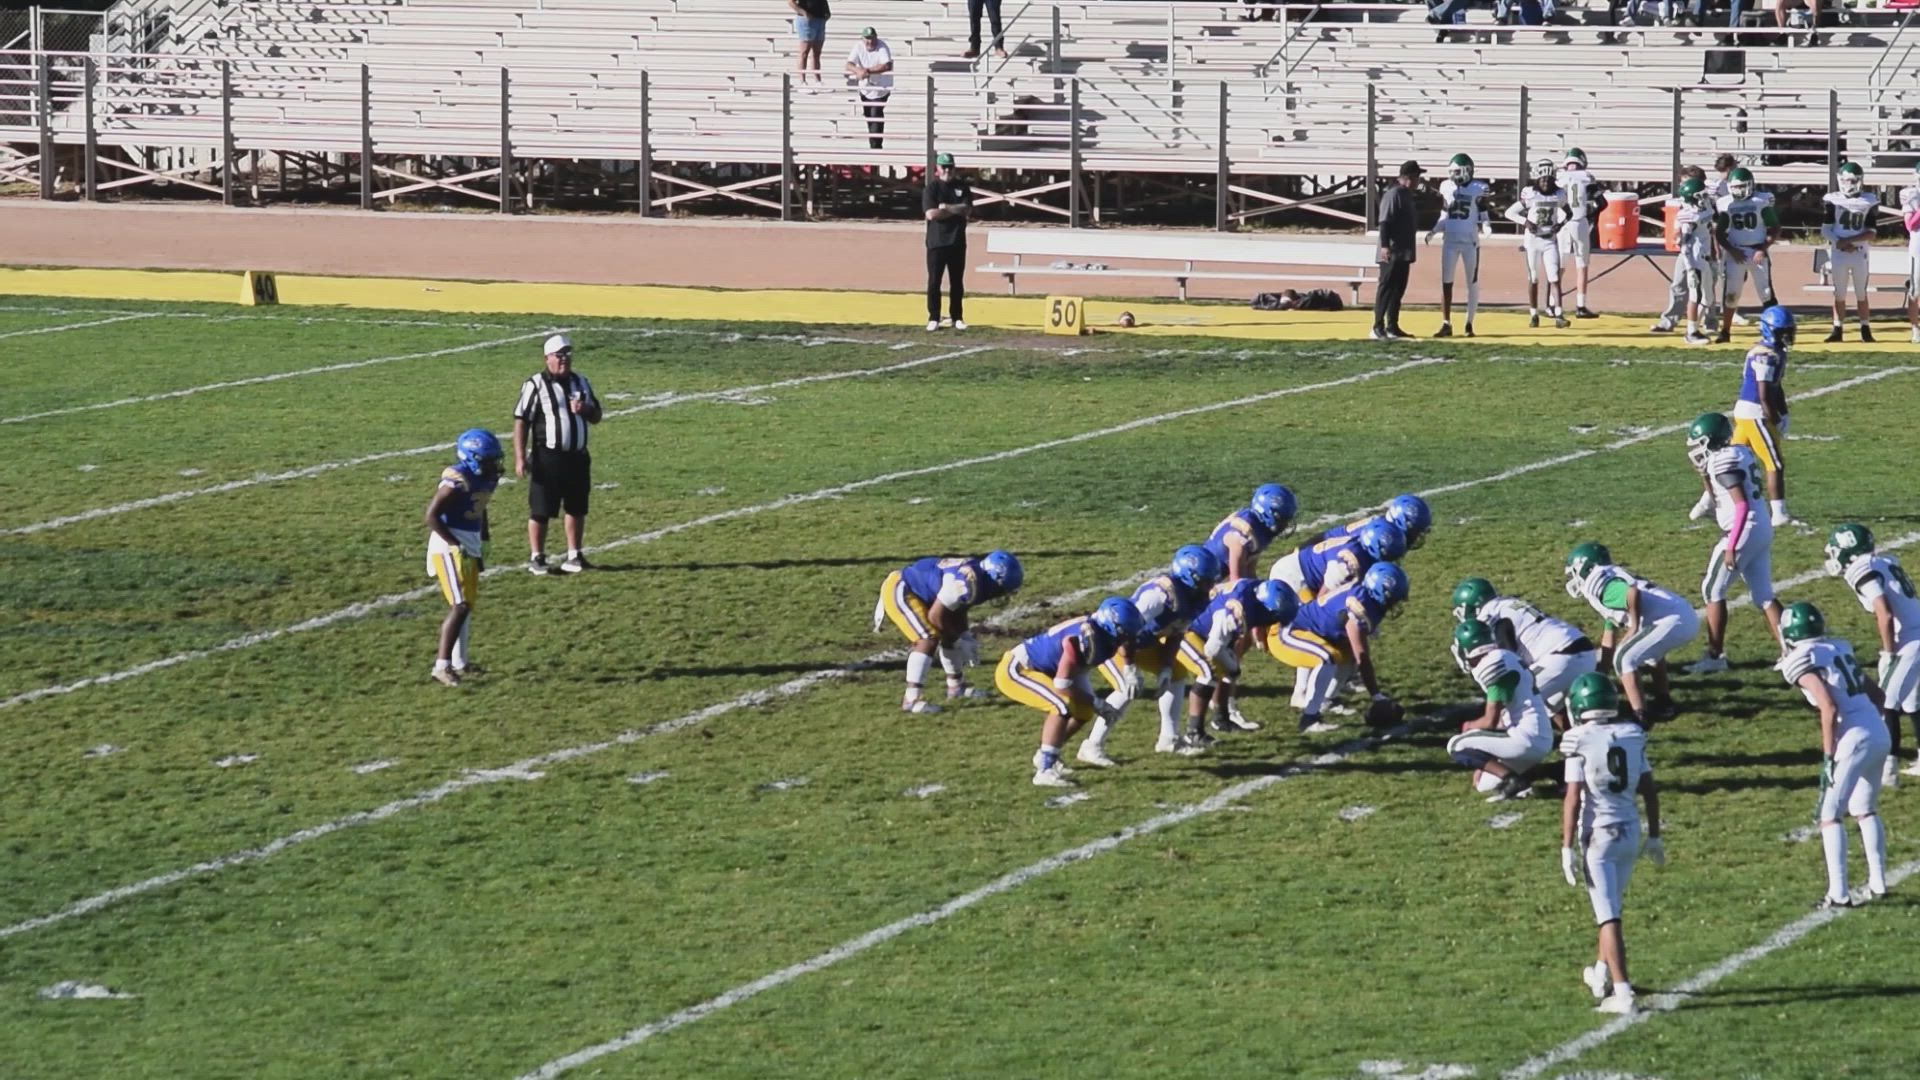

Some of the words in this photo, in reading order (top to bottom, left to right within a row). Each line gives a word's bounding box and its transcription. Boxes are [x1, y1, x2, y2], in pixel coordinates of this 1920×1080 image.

[255, 273, 275, 301] 40
[1051, 299, 1077, 327] 50
[1606, 745, 1629, 794] 9
